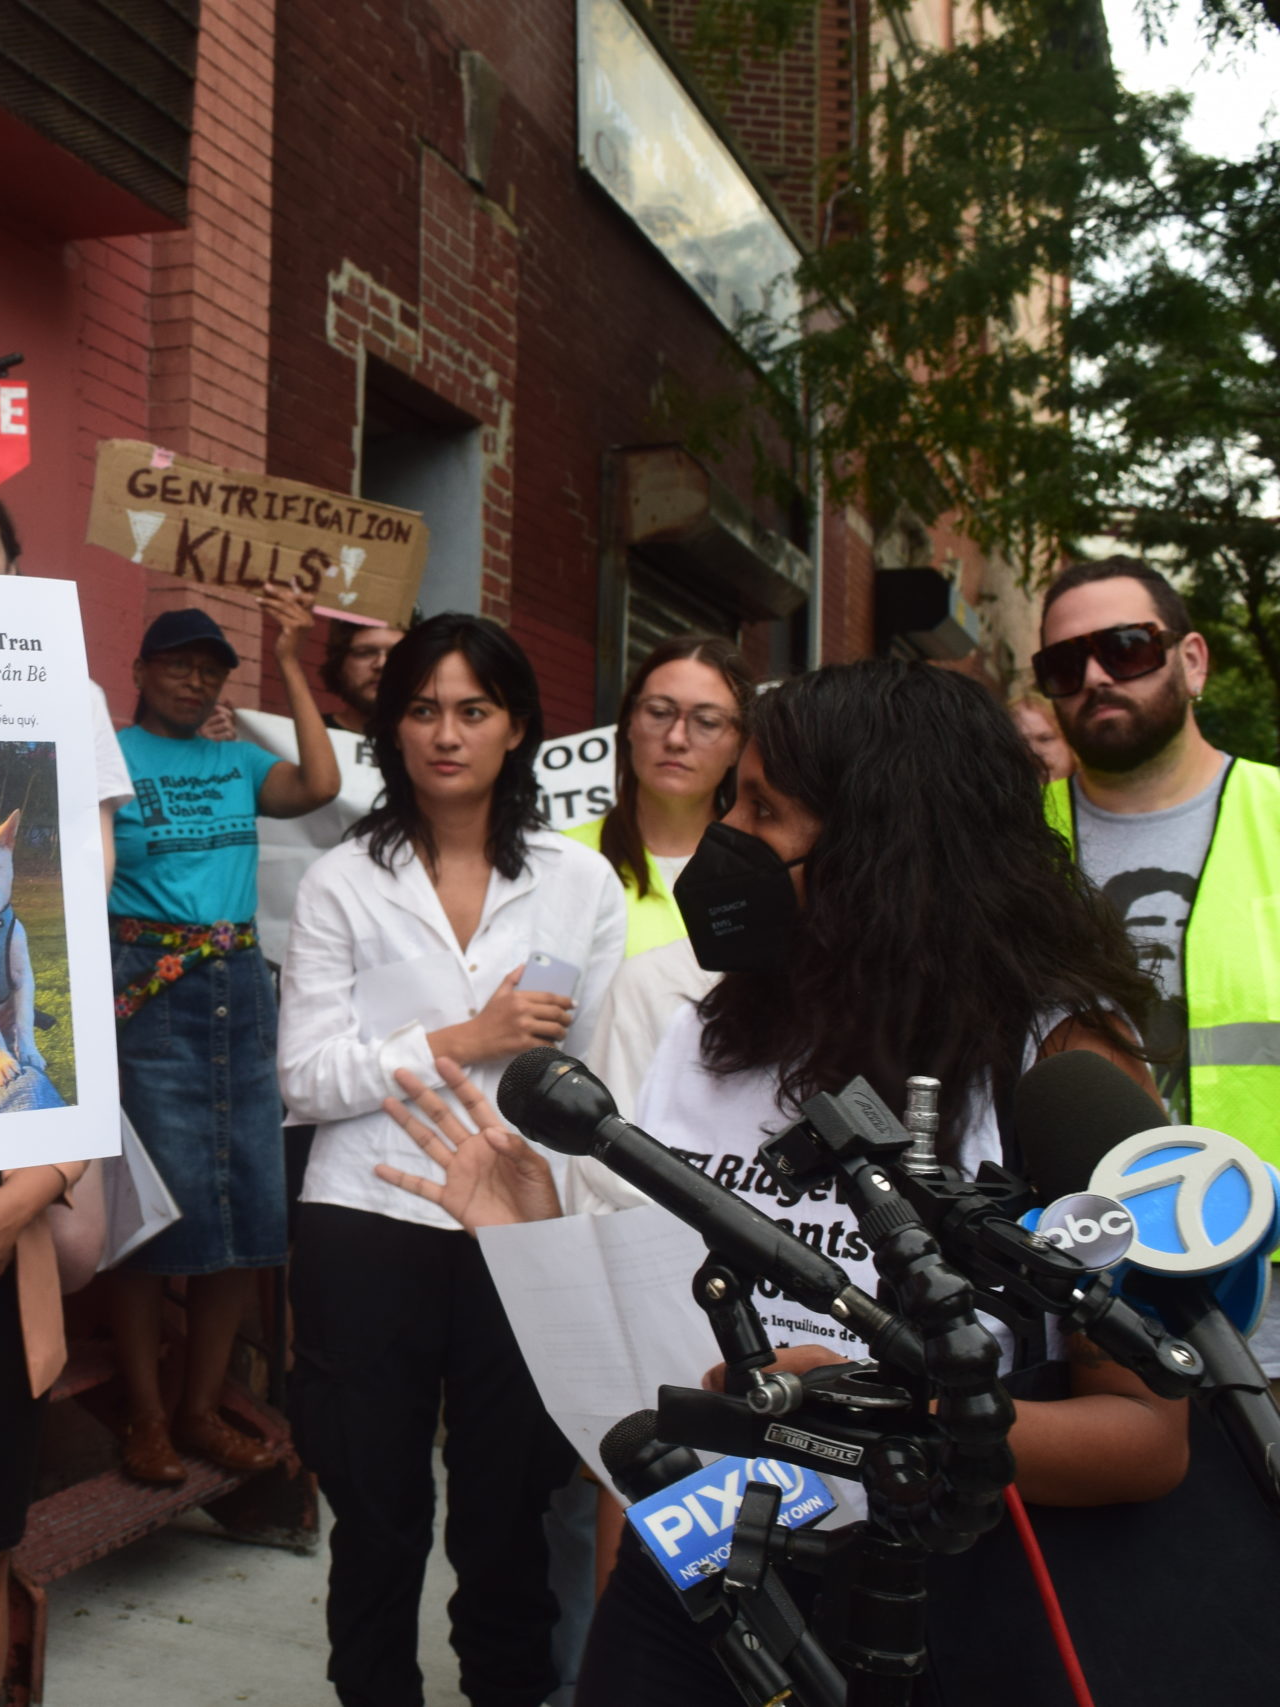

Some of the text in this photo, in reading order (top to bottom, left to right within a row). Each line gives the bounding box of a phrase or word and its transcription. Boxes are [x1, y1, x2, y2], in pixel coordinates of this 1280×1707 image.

[127, 467, 413, 545] GENTRIFICATION
[174, 517, 332, 593] KILLS
[26, 664, 48, 682] Bê
[1042, 1209, 1133, 1252] abc
[771, 1314, 836, 1338] Inquilinos
[839, 1324, 857, 1344] de
[790, 1495, 824, 1520] OWN
